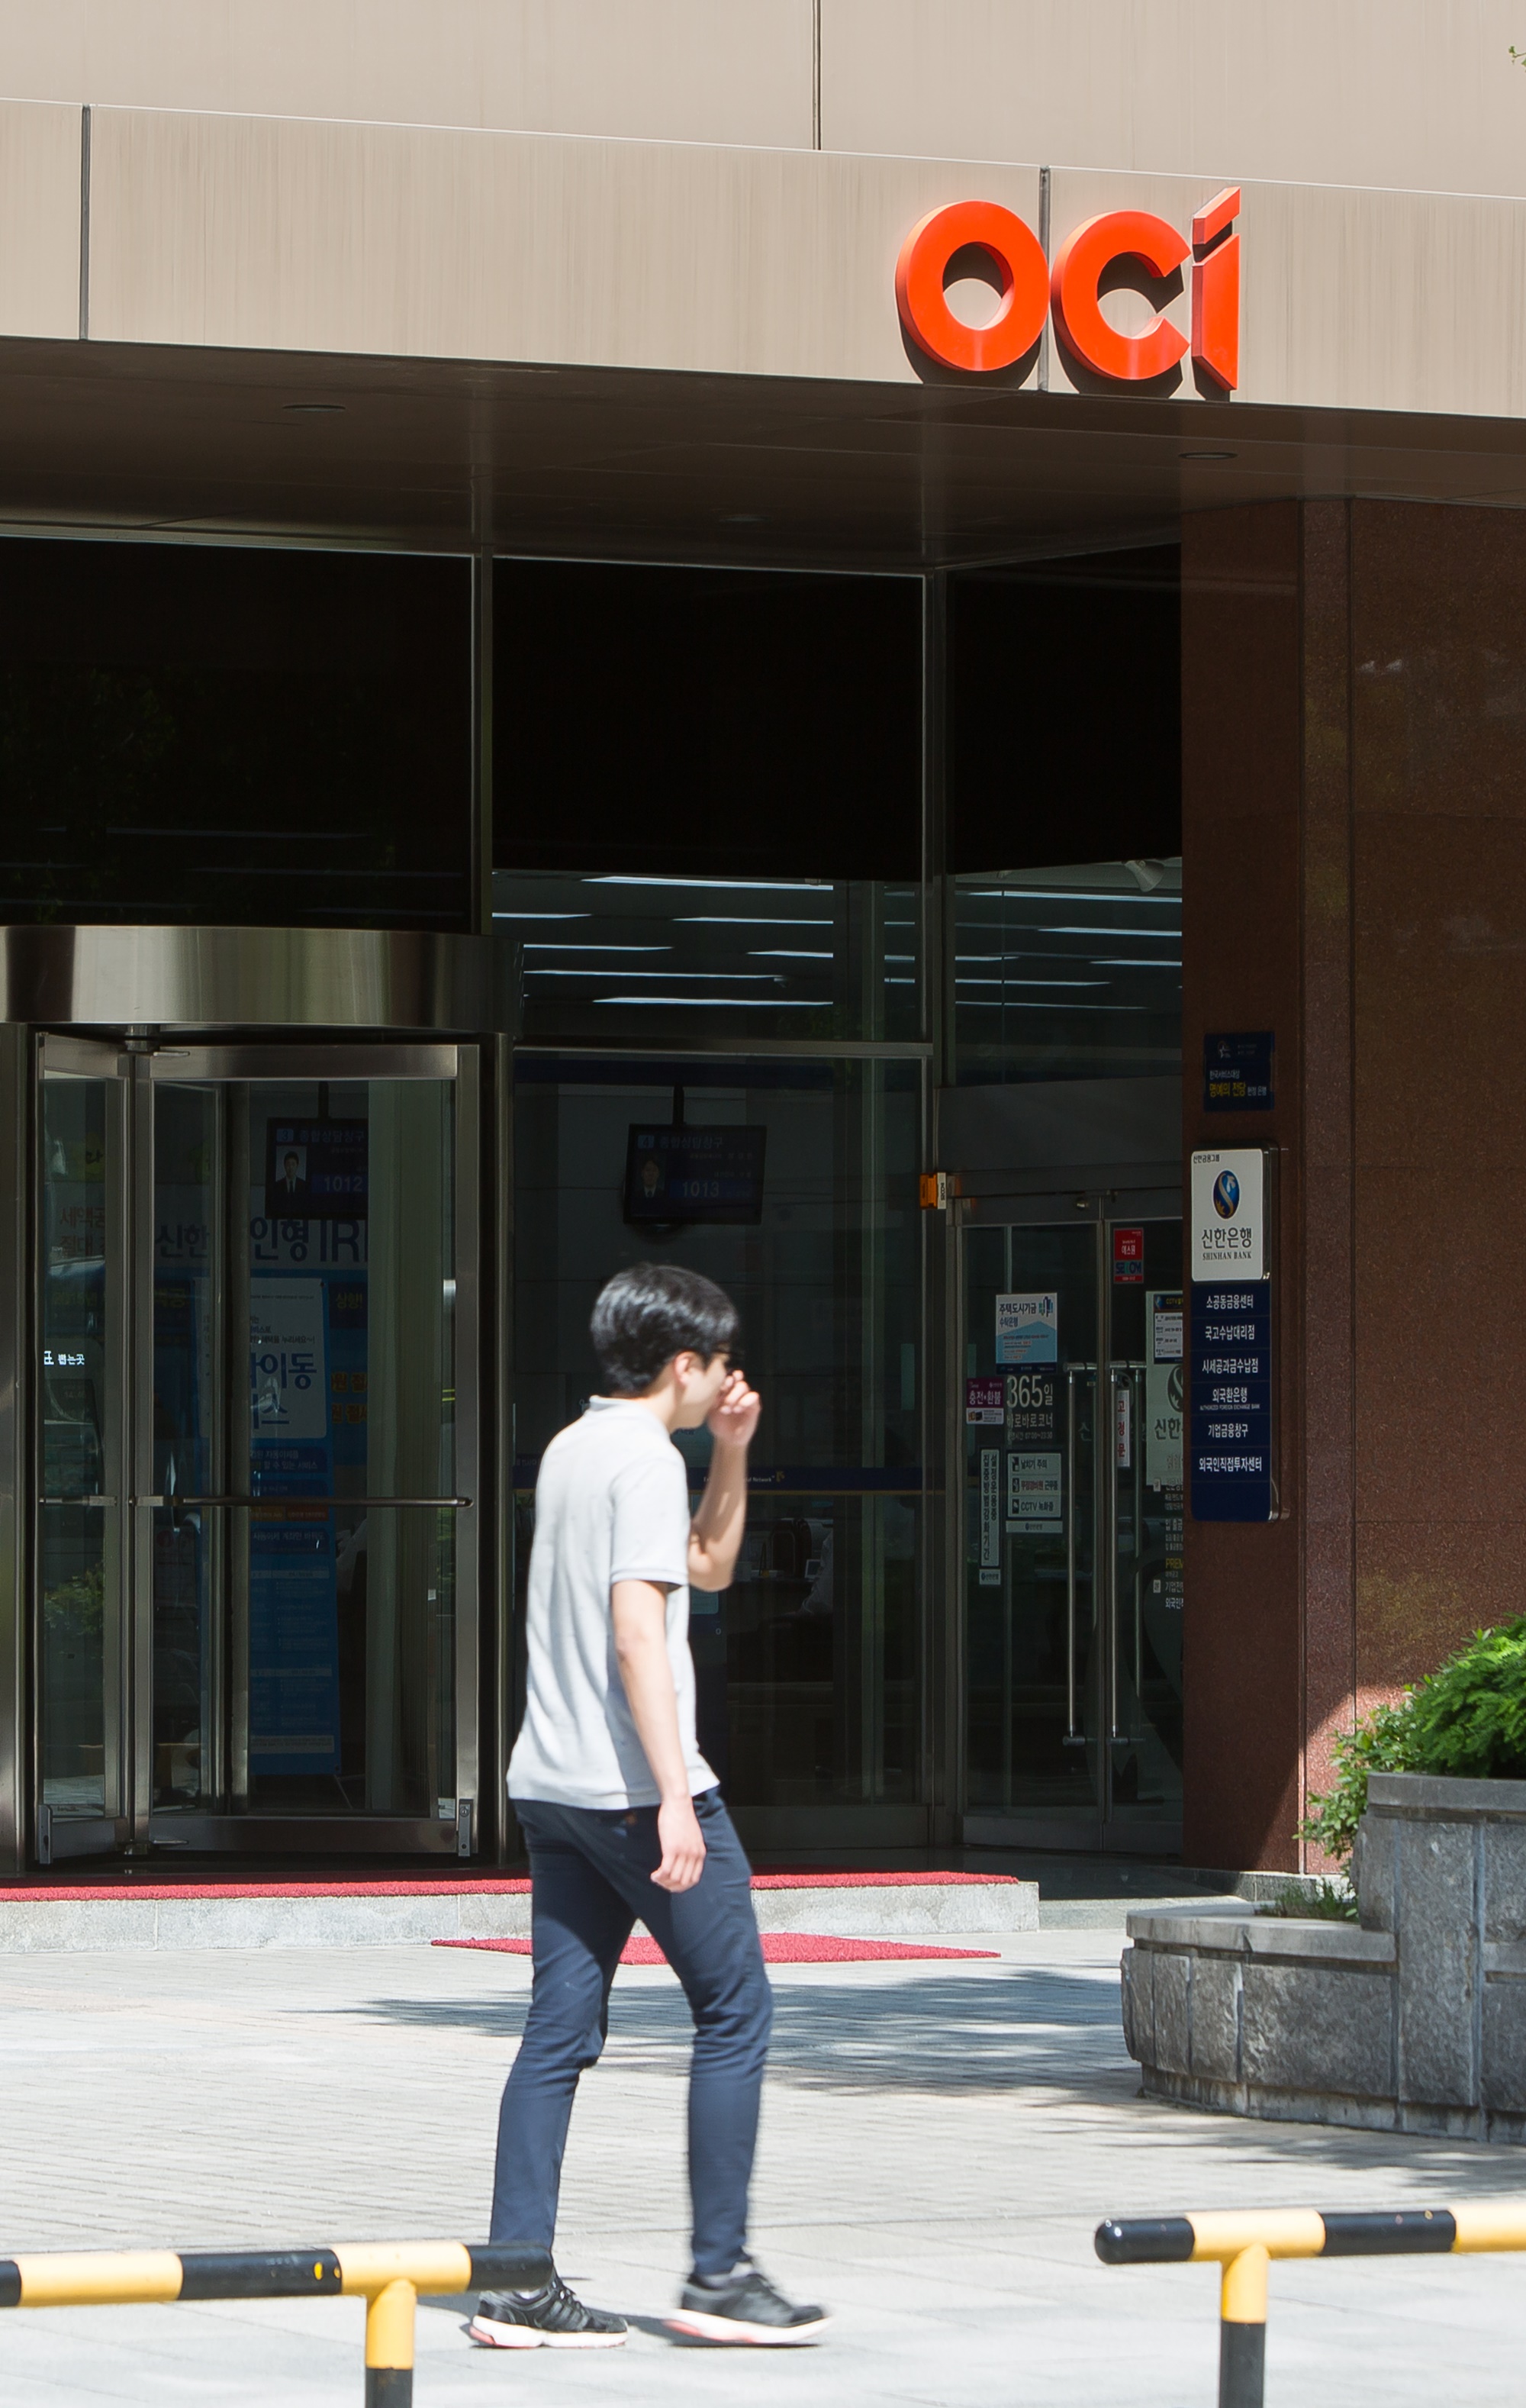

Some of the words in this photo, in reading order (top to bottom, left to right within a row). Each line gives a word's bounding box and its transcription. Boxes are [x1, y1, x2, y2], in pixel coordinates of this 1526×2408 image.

[1209, 1082, 1230, 1098] 명예의
[1232, 1082, 1246, 1098] 전당
[1193, 1154, 1220, 1164] 신한금융그룹
[324, 1176, 363, 1191] 1012
[681, 1181, 720, 1198] 1013
[1202, 1227, 1252, 1249] 신한은행
[1202, 1252, 1232, 1261] SHINHAN
[1234, 1251, 1252, 1259] BANK
[1116, 1262, 1141, 1274] SECOM
[1000, 1302, 1036, 1315] 주택도시기금
[1206, 1294, 1254, 1310] 소공동금융센터
[1205, 1324, 1255, 1341] 국고수납대리점
[57, 1353, 85, 1365] 뽑는곳
[1202, 1358, 1258, 1374] 시세공과금수납점
[1006, 1375, 1053, 1408] 365일
[1212, 1387, 1248, 1403] 외국환은행
[1007, 1412, 1053, 1428] 바로바로코너
[1117, 1400, 1125, 1458] 고정문
[1154, 1417, 1183, 1440] 신한
[1208, 1423, 1249, 1439] 기업금융창구
[1021, 1459, 1035, 1470] 날치기
[1037, 1459, 1048, 1469] 주의
[1199, 1456, 1262, 1472] 외국인직접투자센터
[1021, 1501, 1038, 1511] CCTV
